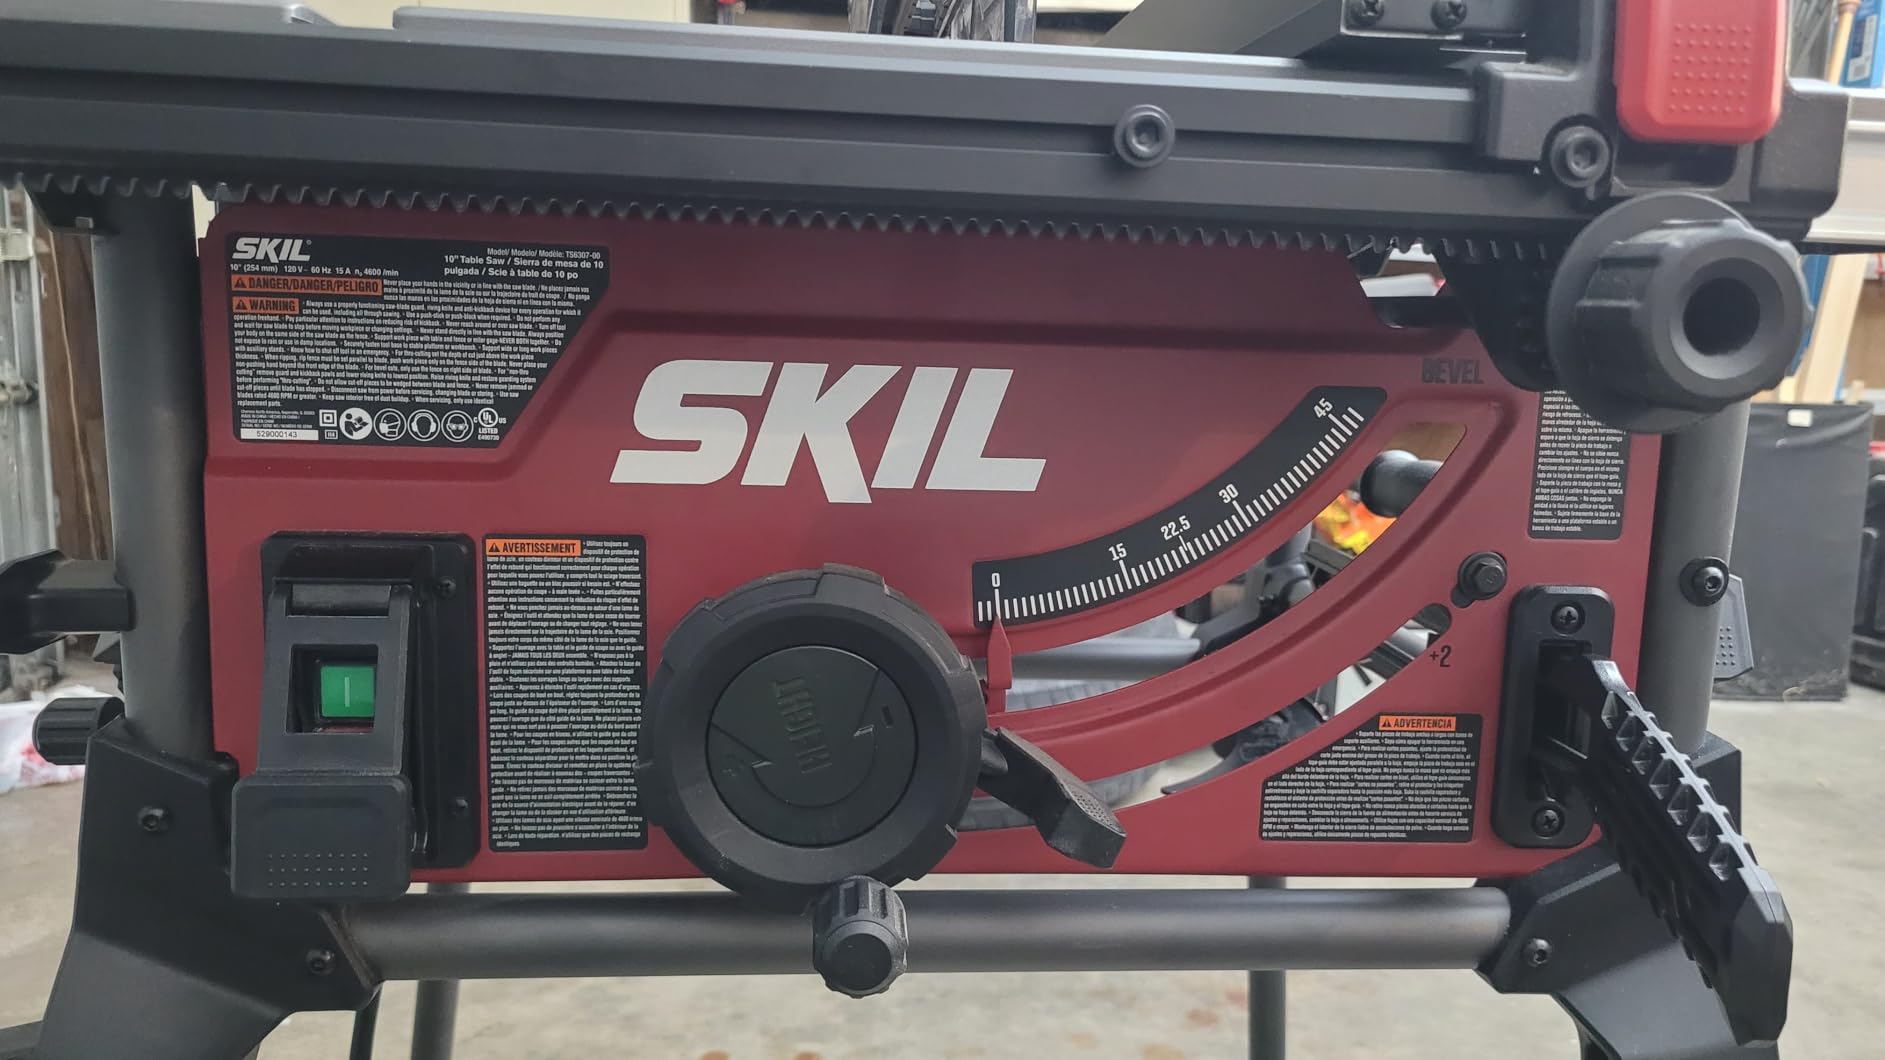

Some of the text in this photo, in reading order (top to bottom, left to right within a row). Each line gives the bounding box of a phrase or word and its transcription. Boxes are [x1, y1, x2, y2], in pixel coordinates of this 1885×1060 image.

[232, 237, 311, 263] SKIL
[566, 250, 600, 259] TS6307-00
[244, 264, 259, 272] (254
[261, 265, 278, 273] mm)
[444, 255, 458, 263] 10"
[461, 256, 484, 264] Table
[486, 256, 505, 264] Saw
[514, 258, 540, 266] Sierra
[542, 259, 553, 267] de
[580, 260, 592, 268] de
[444, 267, 479, 276] pulgada
[488, 268, 507, 276] Scie
[517, 270, 539, 278] table
[567, 272, 578, 280] po
[250, 278, 378, 292] DANGER/DANGER/PELIGRO
[250, 300, 295, 312] WARNING
[1422, 358, 1484, 384] BEVEL
[1313, 398, 1333, 419] 45
[609, 359, 1046, 503] SKIL
[1218, 484, 1239, 503] 30
[1161, 515, 1191, 541] 22.5
[502, 542, 576, 553] AVERTISSEMENT
[1108, 543, 1128, 561] 15
[991, 572, 1000, 587] 0
[1430, 645, 1451, 667] +2
[1394, 719, 1452, 729] ADVERTENCIA
